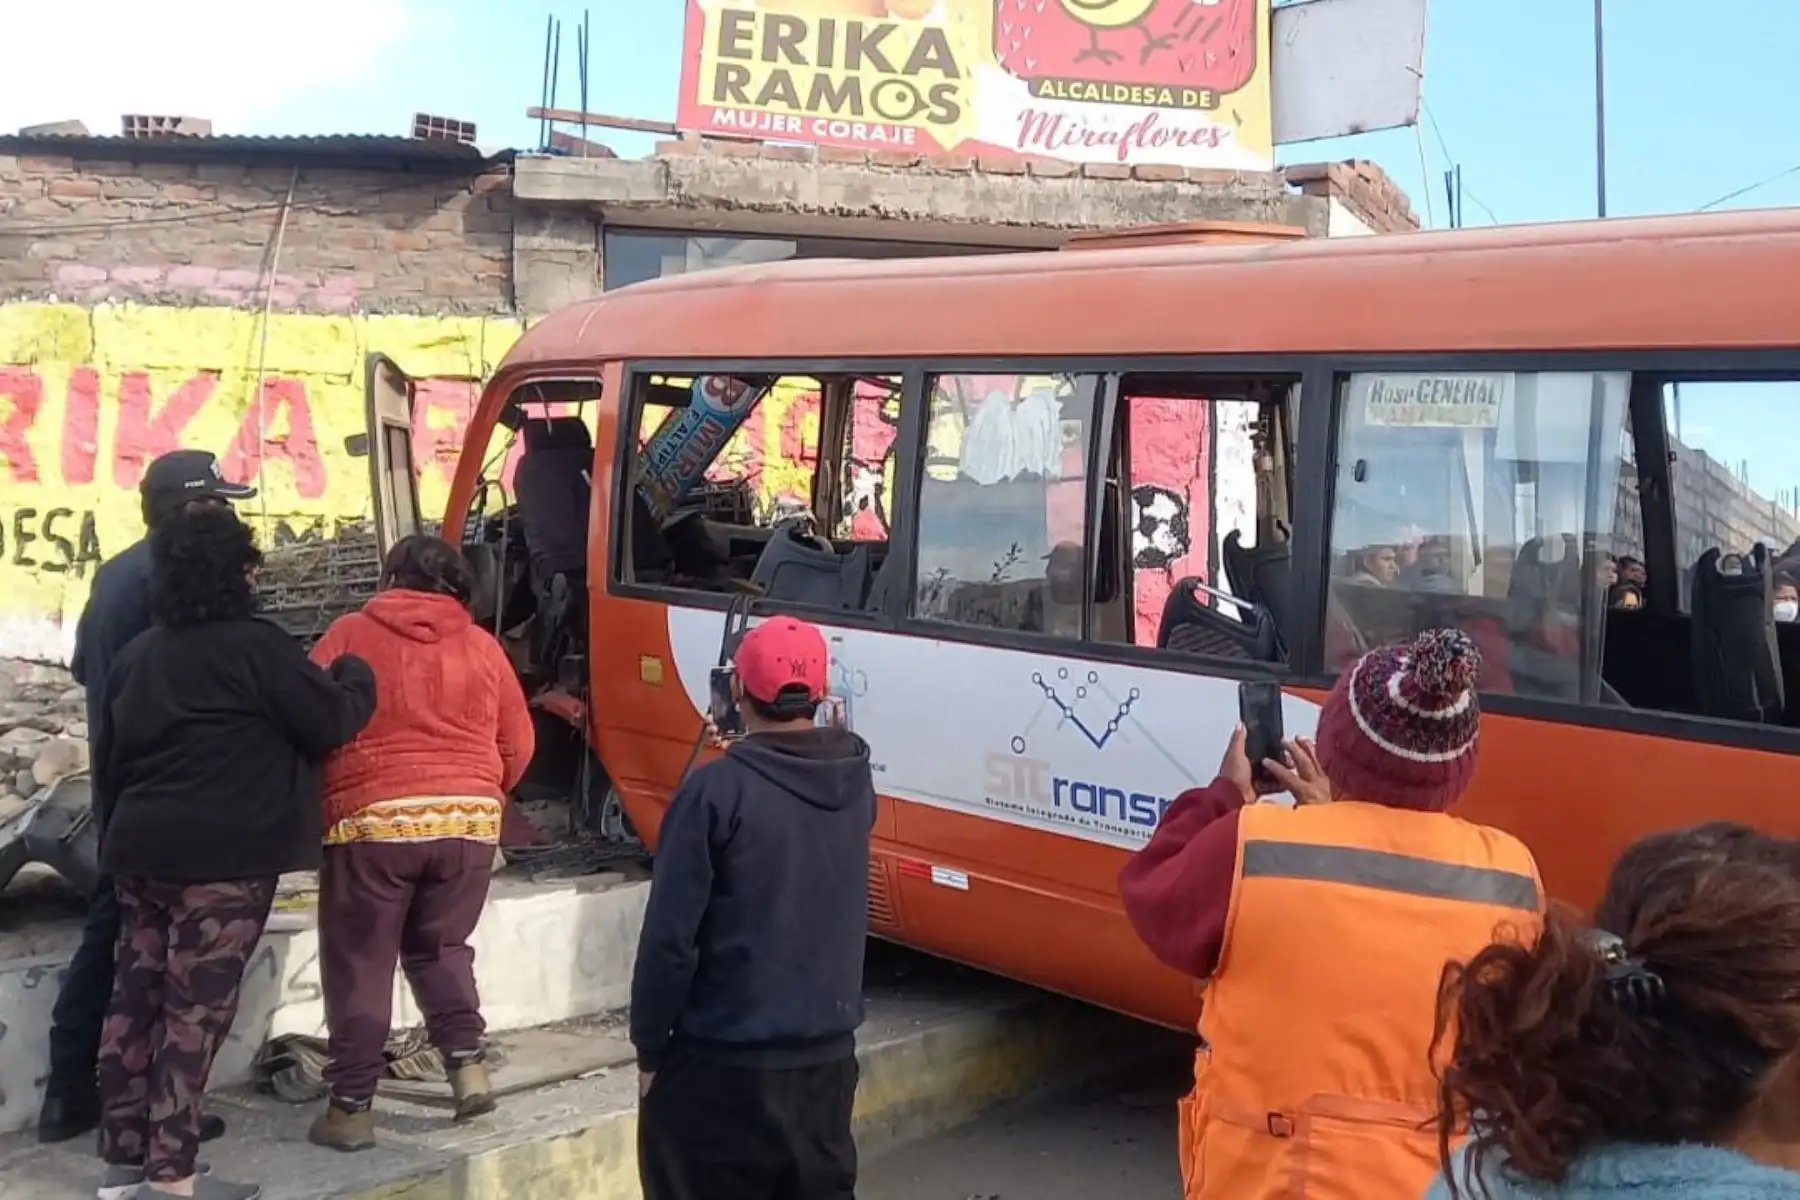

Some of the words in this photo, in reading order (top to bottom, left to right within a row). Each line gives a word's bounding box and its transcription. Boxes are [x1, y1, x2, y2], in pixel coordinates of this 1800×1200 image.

[717, 8, 961, 79] ERIKA
[713, 62, 961, 125] RAMOS
[1038, 79, 1174, 106] ALCALDESA
[1182, 89, 1211, 107] DE
[712, 108, 803, 134] MUJER
[811, 119, 916, 145] CORAJE
[1016, 108, 1231, 161] Miraflores
[1416, 378, 1498, 405] GENERAL
[0, 507, 102, 580] ESA
